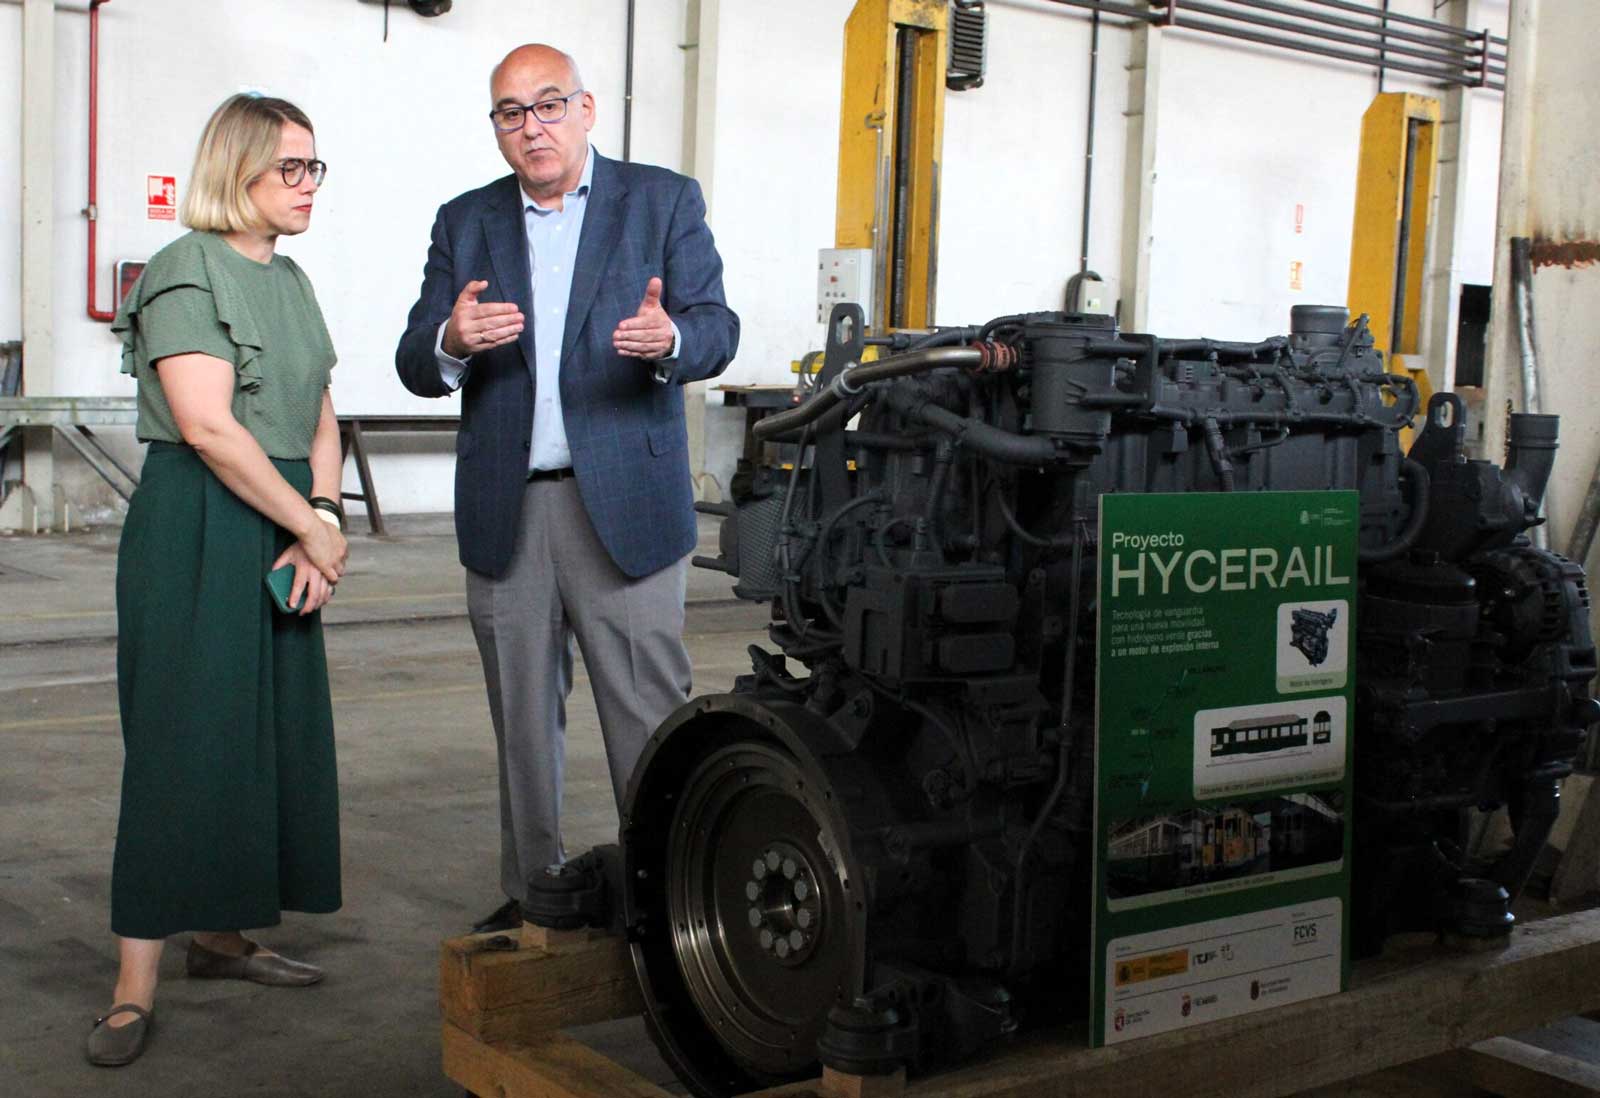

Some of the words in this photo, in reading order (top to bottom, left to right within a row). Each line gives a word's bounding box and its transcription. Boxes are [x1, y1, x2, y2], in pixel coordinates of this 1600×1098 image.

[1112, 531, 1185, 550] Proyecto
[1111, 545, 1350, 597] HYCERAIL
[1129, 646, 1149, 656] motor
[1151, 644, 1160, 655] de
